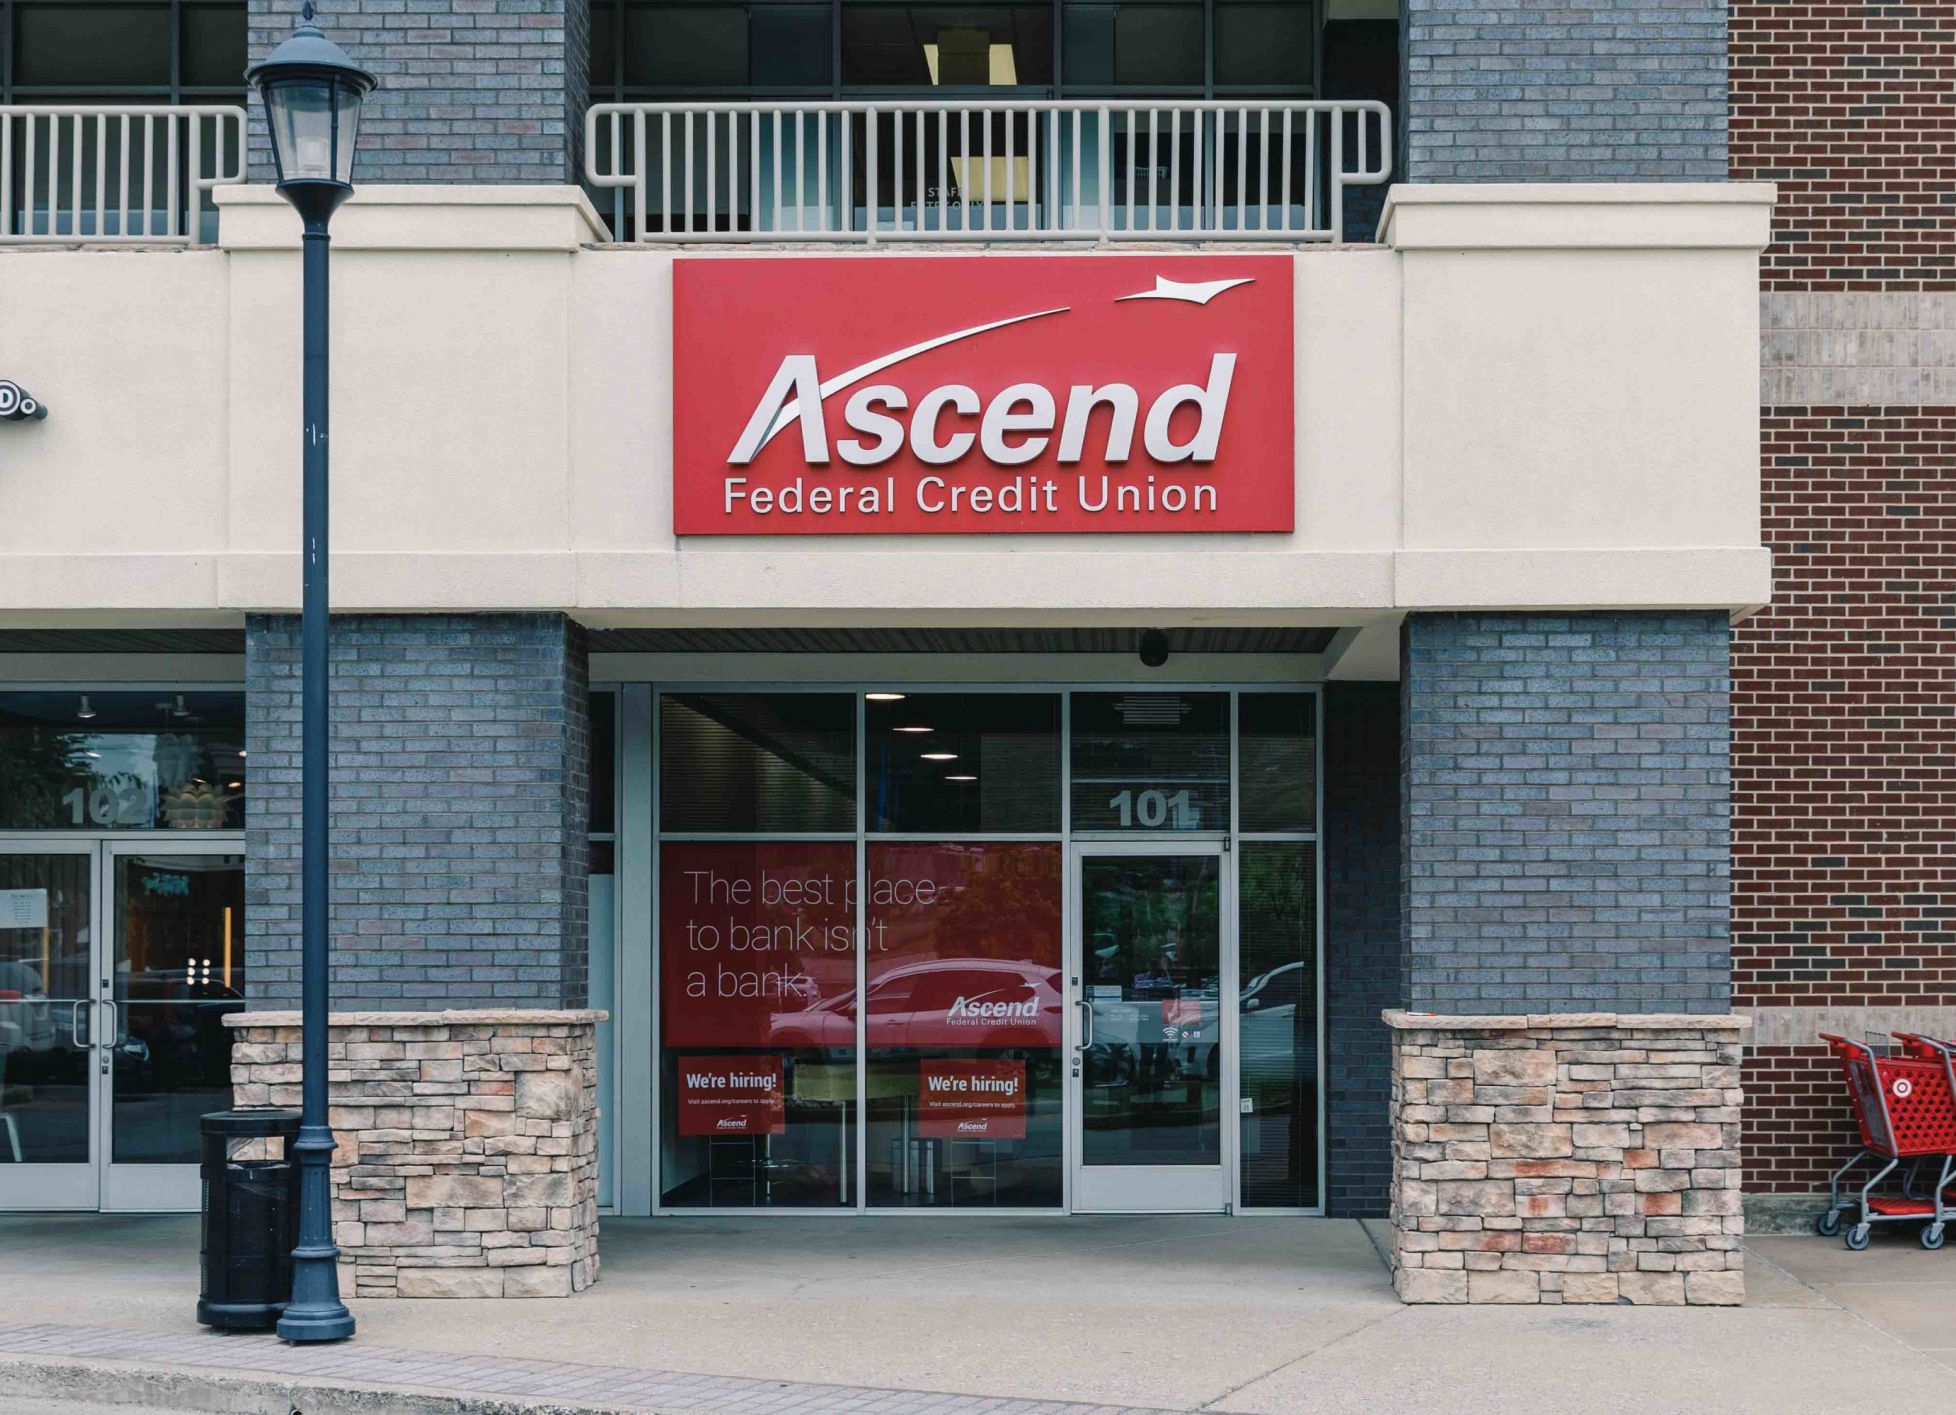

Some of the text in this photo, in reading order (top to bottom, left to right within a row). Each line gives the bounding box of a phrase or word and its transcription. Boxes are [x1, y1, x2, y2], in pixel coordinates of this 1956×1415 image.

[727, 352, 1237, 465] Ascend
[724, 476, 1218, 513] Federal Credit Union
[62, 787, 149, 825] 102
[1109, 788, 1190, 828] 101
[683, 869, 937, 914] The best place
[686, 919, 719, 952] to
[730, 915, 816, 952] bank
[686, 962, 807, 998] a bank.
[946, 1017, 1037, 1026] Federal Credit Union
[947, 996, 1040, 1017] Ascend
[686, 1072, 776, 1091] We're hiring!
[928, 1076, 1018, 1095] We're hiring!
[716, 1119, 747, 1127] Ascend
[957, 1122, 988, 1131] Ascend
